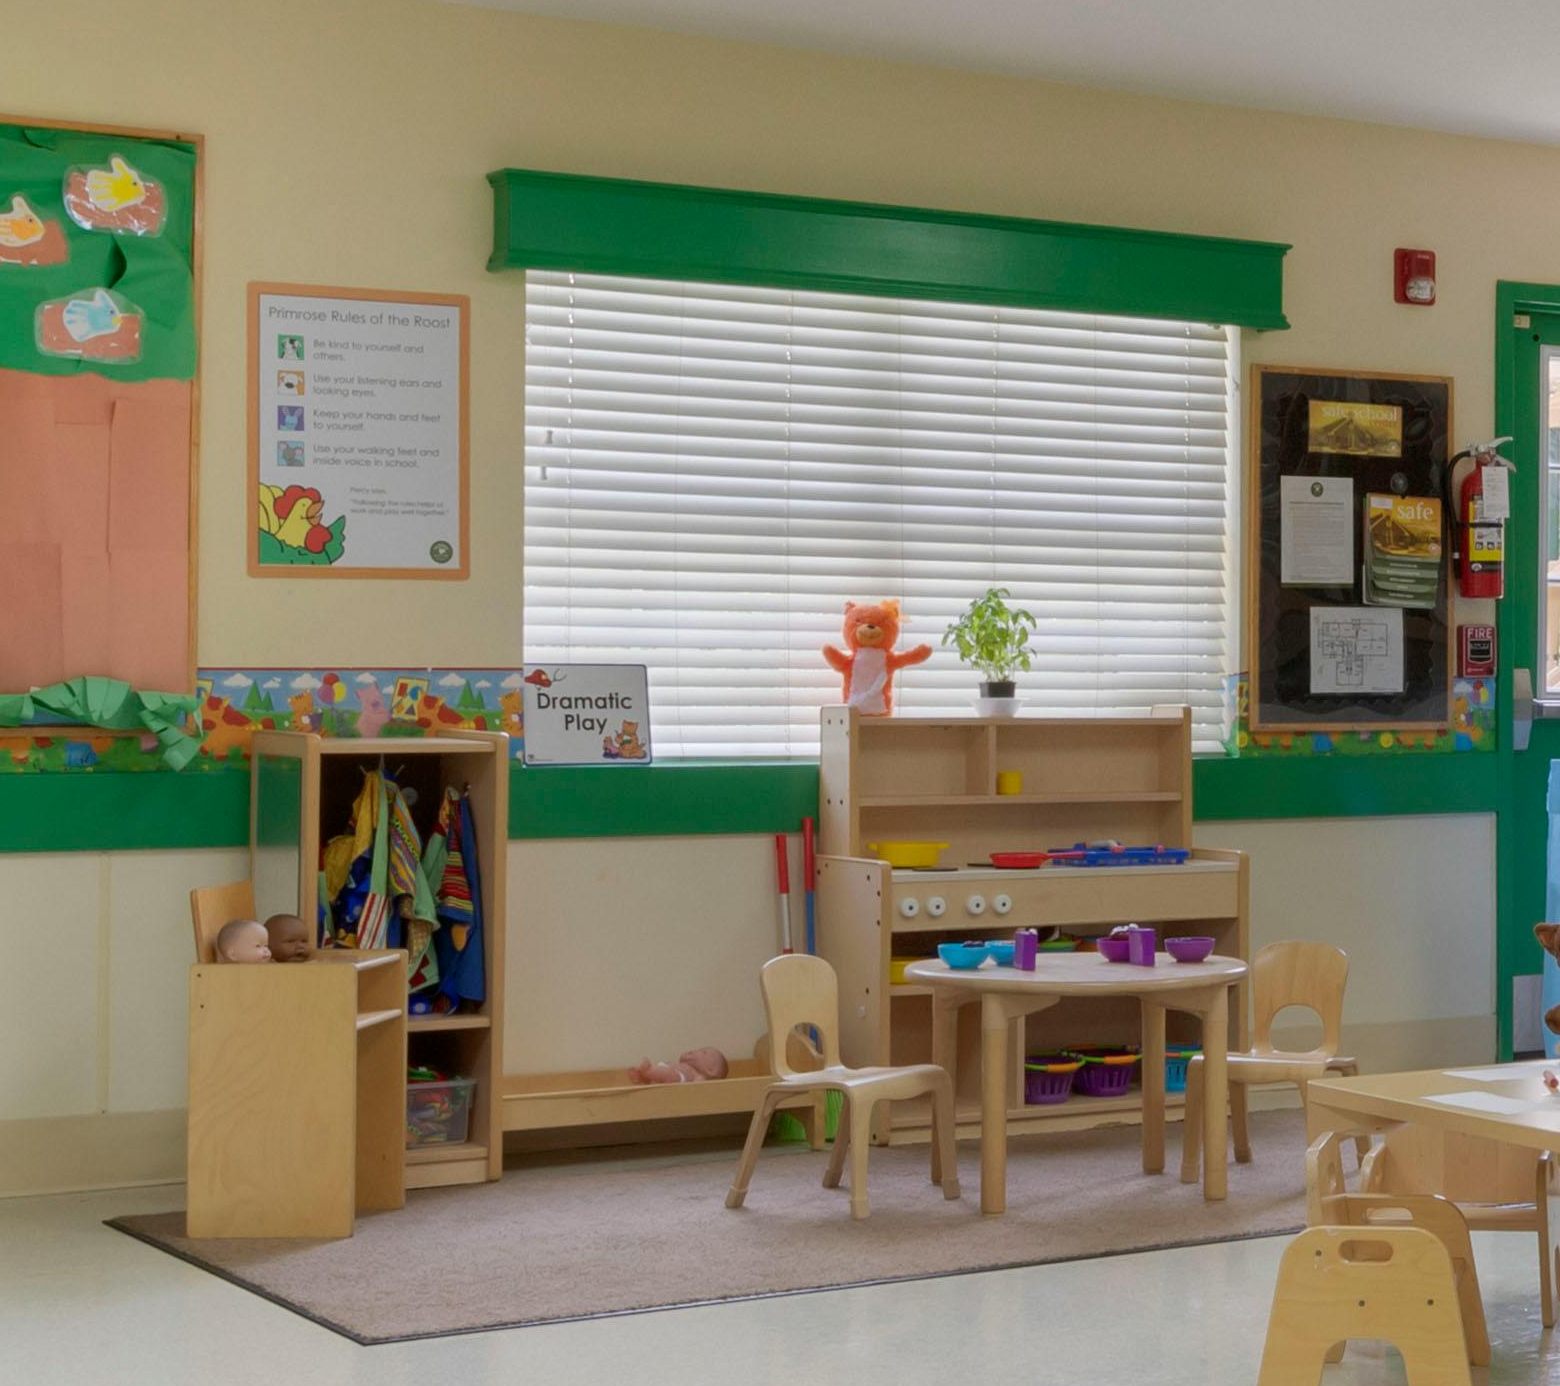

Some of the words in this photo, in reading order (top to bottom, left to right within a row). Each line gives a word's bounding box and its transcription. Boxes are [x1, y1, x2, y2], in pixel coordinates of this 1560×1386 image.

[268, 307, 327, 322] Primrose
[331, 310, 366, 324] Rules
[369, 312, 384, 325] of
[388, 314, 410, 327] the
[414, 316, 450, 329] Roost
[313, 339, 326, 348] Be
[328, 339, 350, 350] kind
[352, 341, 362, 350] to
[364, 343, 402, 354] yourself
[403, 344, 424, 354] and
[313, 351, 345, 362] others.
[313, 374, 331, 383] Use
[333, 376, 355, 385] your
[357, 376, 397, 388] listening
[399, 380, 419, 388] ears
[421, 380, 442, 388] and
[313, 386, 349, 397] looking
[313, 409, 340, 420] Keep
[342, 411, 365, 420] your
[366, 411, 397, 421] hands
[399, 413, 419, 422] and
[421, 413, 441, 422] feet
[1352, 407, 1397, 422] school
[313, 422, 324, 430] to
[313, 444, 331, 453] Use
[333, 446, 355, 455] your
[358, 446, 395, 457] walking
[397, 447, 417, 456] feet
[419, 448, 440, 457] and
[313, 456, 342, 466] inside
[344, 458, 372, 467] voice
[374, 458, 383, 467] in
[384, 458, 419, 468] school.
[1396, 502, 1434, 521] safe
[1467, 627, 1493, 639] FIRE
[537, 692, 633, 710] Dramatic
[564, 713, 608, 735] Play
